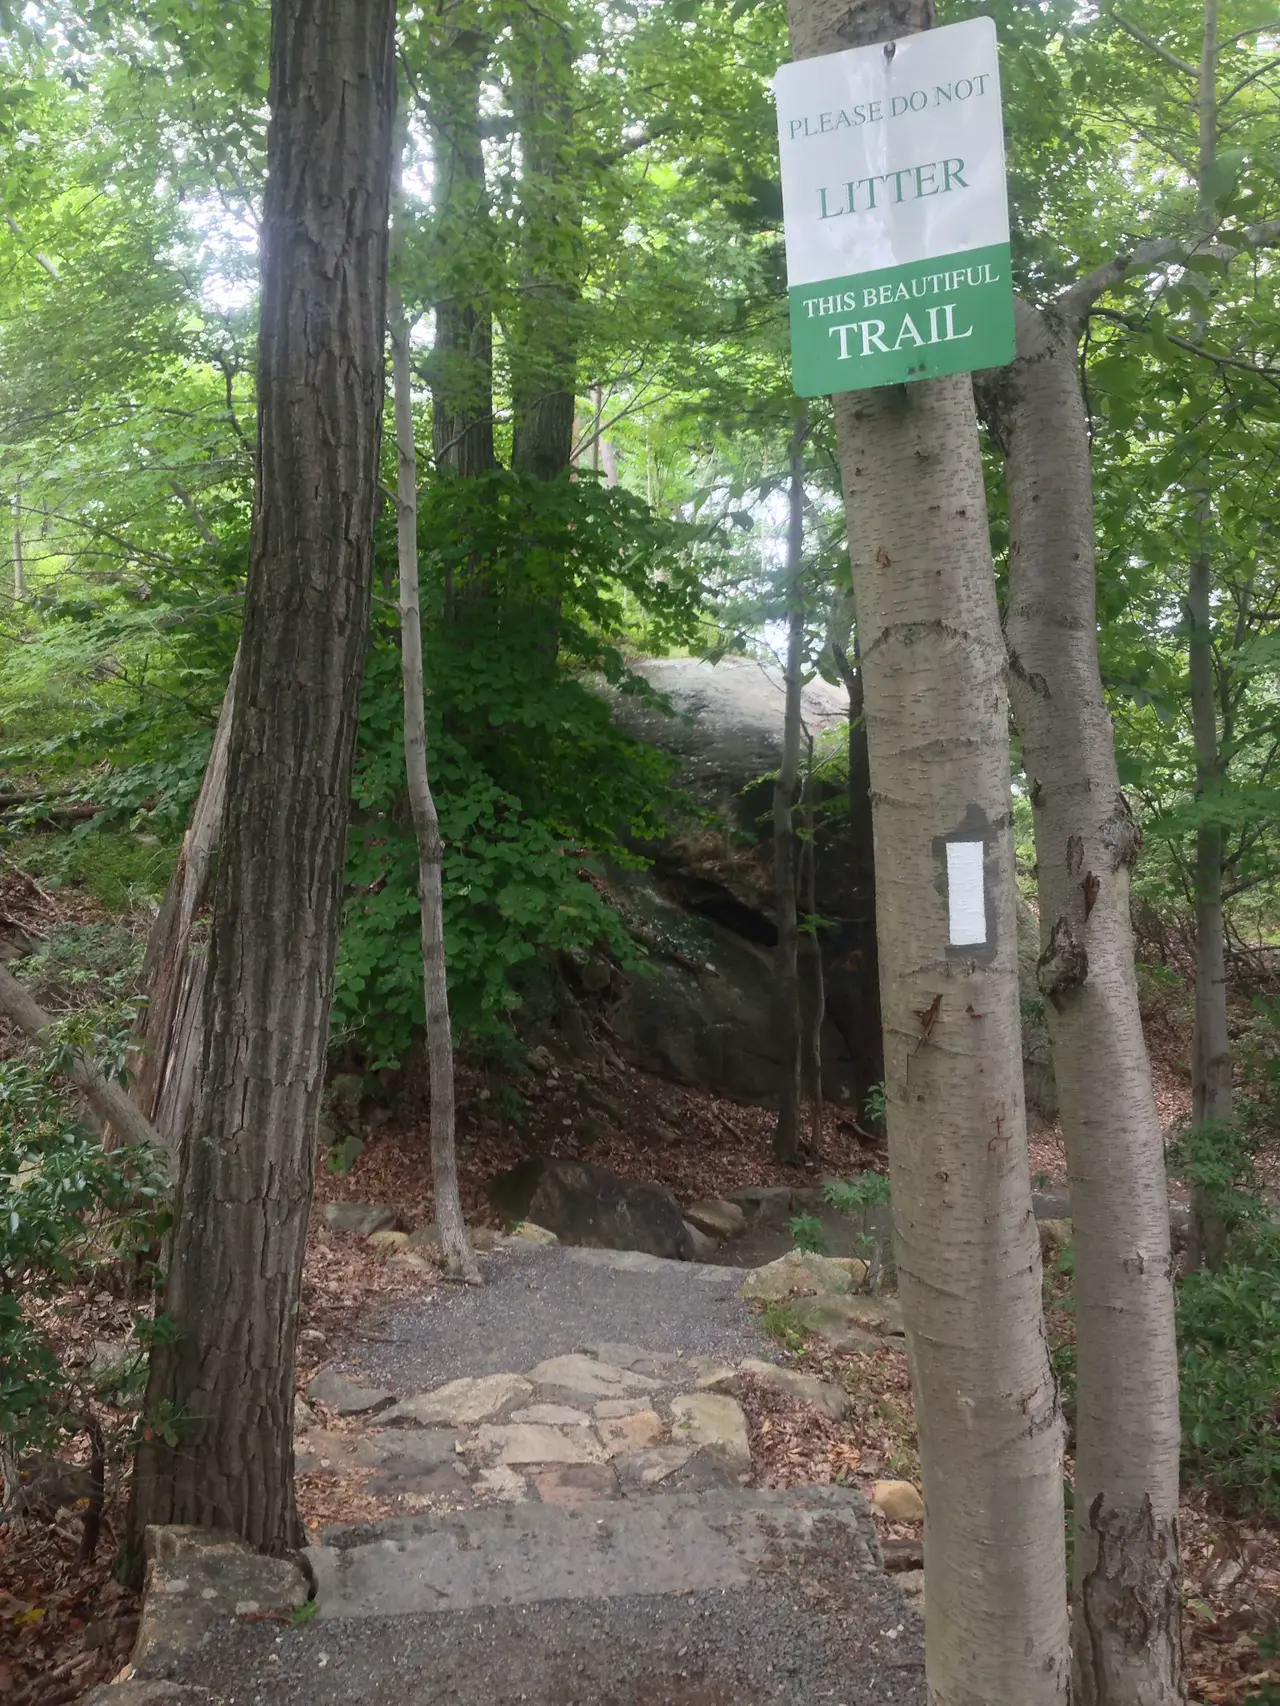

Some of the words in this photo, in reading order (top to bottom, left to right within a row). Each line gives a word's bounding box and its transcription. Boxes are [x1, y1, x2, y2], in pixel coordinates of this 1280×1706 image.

[787, 100, 884, 140] PLEASE
[890, 90, 928, 118] DO
[933, 74, 990, 107] NOT
[816, 157, 970, 220] LITTER
[803, 292, 856, 318] THIS
[862, 263, 1000, 308] BEAUTIFUL
[828, 303, 973, 360] TRAIL
